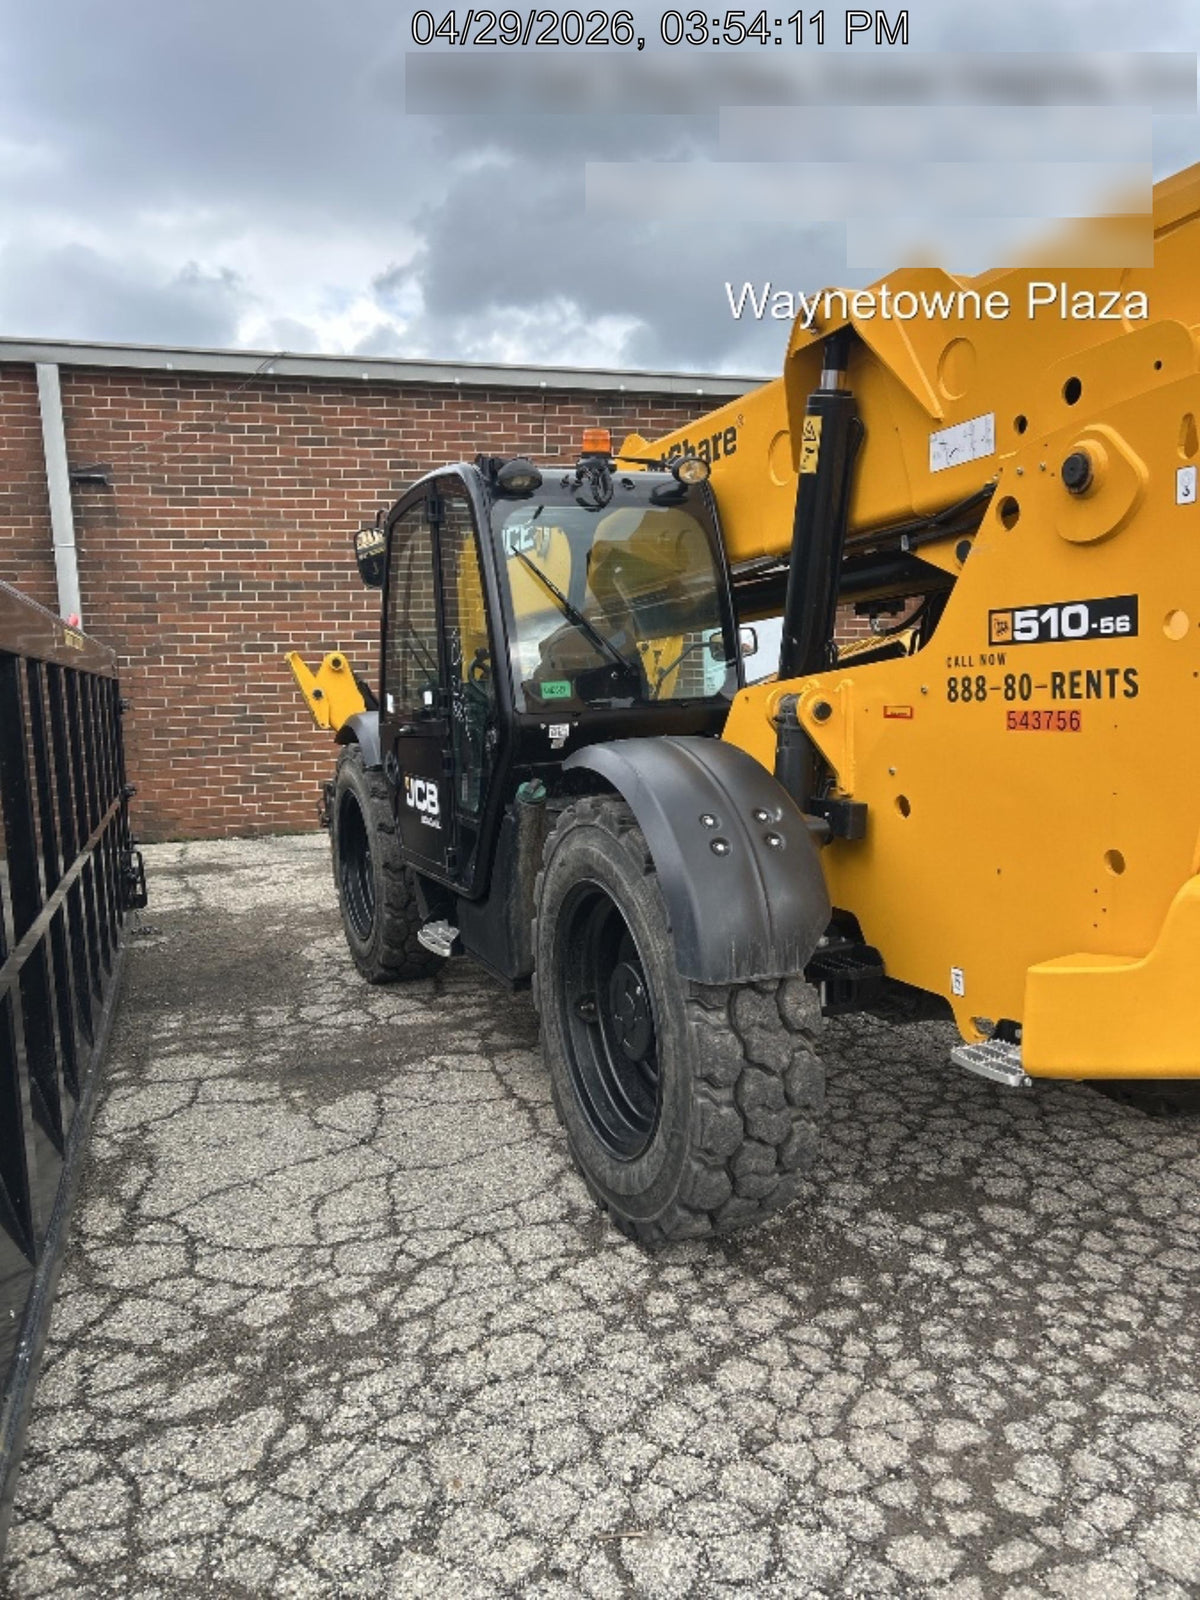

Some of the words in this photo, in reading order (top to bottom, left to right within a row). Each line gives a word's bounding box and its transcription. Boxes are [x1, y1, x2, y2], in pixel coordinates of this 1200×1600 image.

[1012, 603, 1131, 641] 510-56
[946, 655, 974, 669] CALL
[979, 652, 1007, 666] NOW
[947, 667, 1140, 703] 888-80-RENTS
[1006, 710, 1082, 732] 543756
[404, 776, 440, 815] JCB
